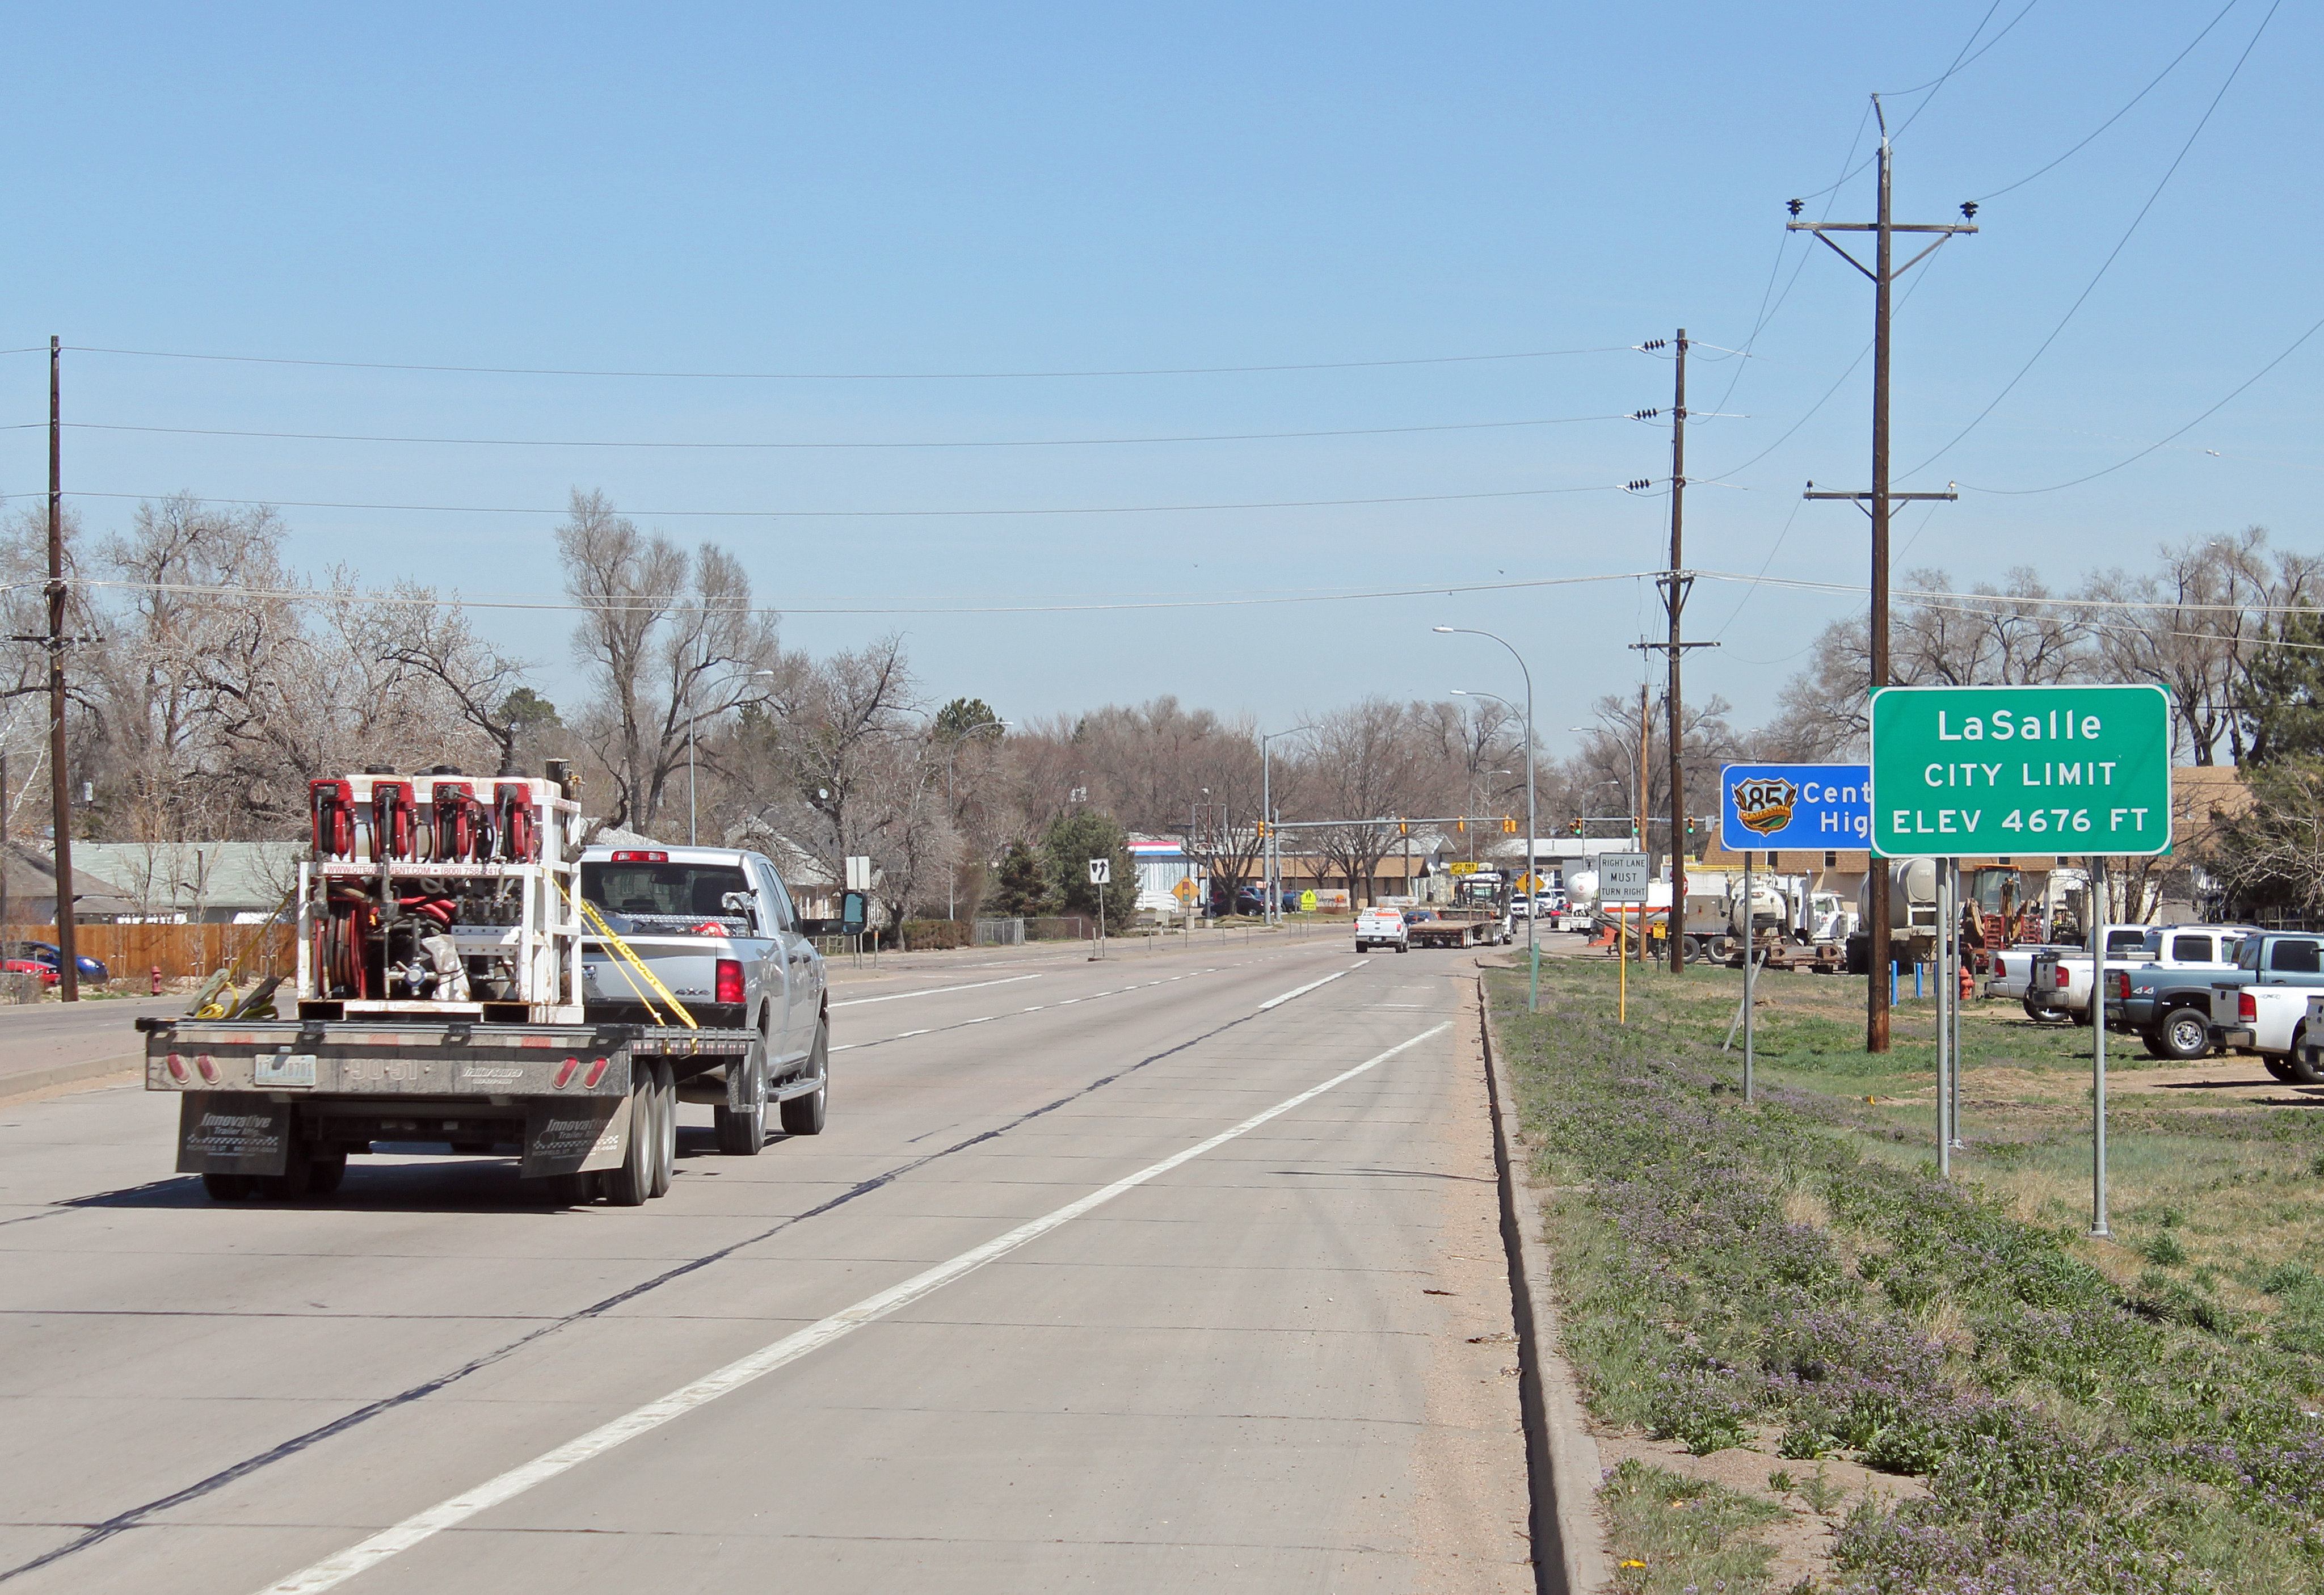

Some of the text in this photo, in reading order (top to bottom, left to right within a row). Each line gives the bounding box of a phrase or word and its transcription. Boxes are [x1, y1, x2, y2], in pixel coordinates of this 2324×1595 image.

[1939, 709, 2101, 740] LaSalle
[1924, 762, 2116, 787] CITY LIMIT
[1748, 786, 1783, 811] 85
[1893, 808, 2149, 834] ELEV 4676 FT
[1626, 859, 1645, 868] LANE
[441, 865, 461, 876] (800)
[1610, 873, 1637, 882] MUST
[1601, 887, 1645, 896] TURN RIGHT
[462, 1067, 523, 1077] Trailer Source
[201, 1113, 272, 1128] Innovative
[214, 1126, 242, 1135] Trailer
